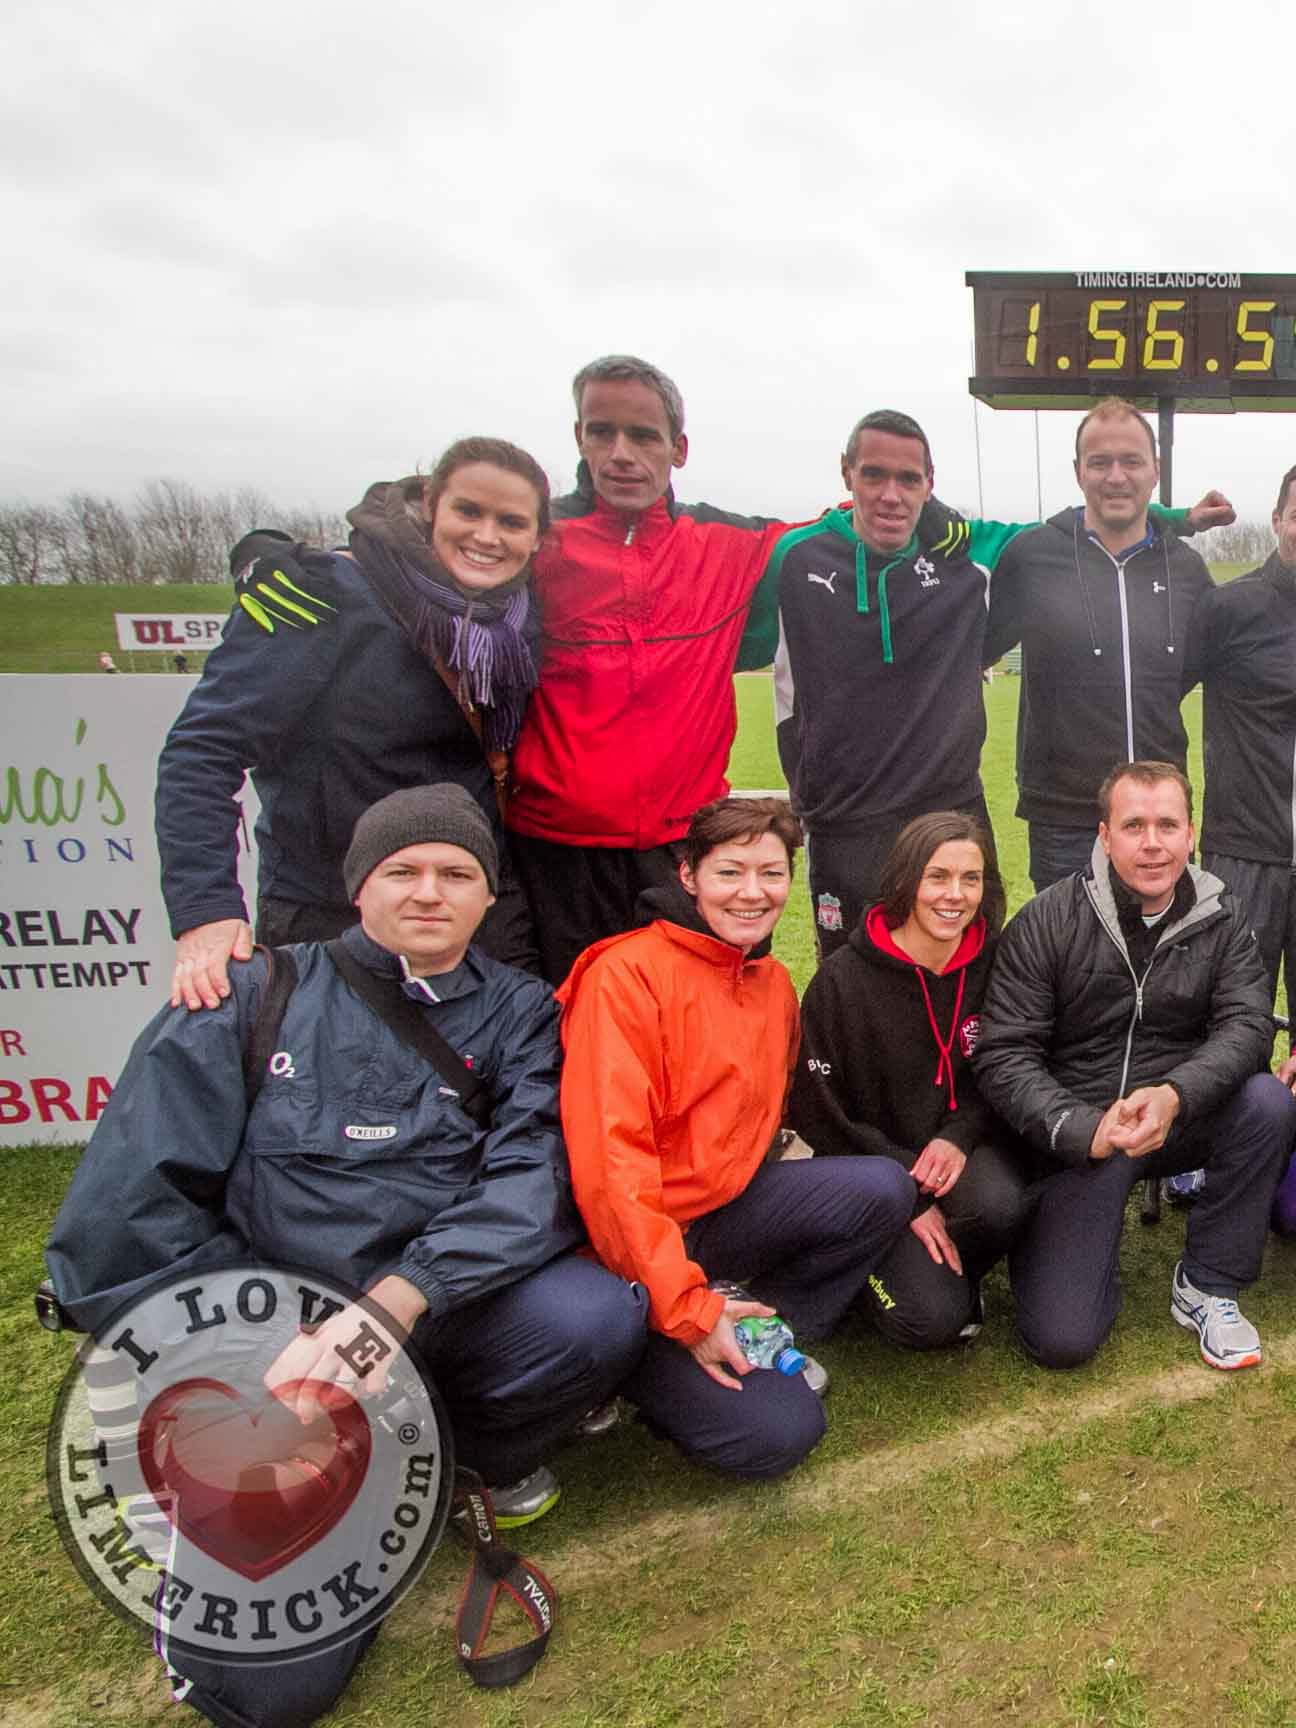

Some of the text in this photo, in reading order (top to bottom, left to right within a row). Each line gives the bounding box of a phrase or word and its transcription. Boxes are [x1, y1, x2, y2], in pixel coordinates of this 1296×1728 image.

[0, 838, 134, 863] ION
[0, 908, 141, 947] RELAY
[469, 1493, 493, 1543] Canon
